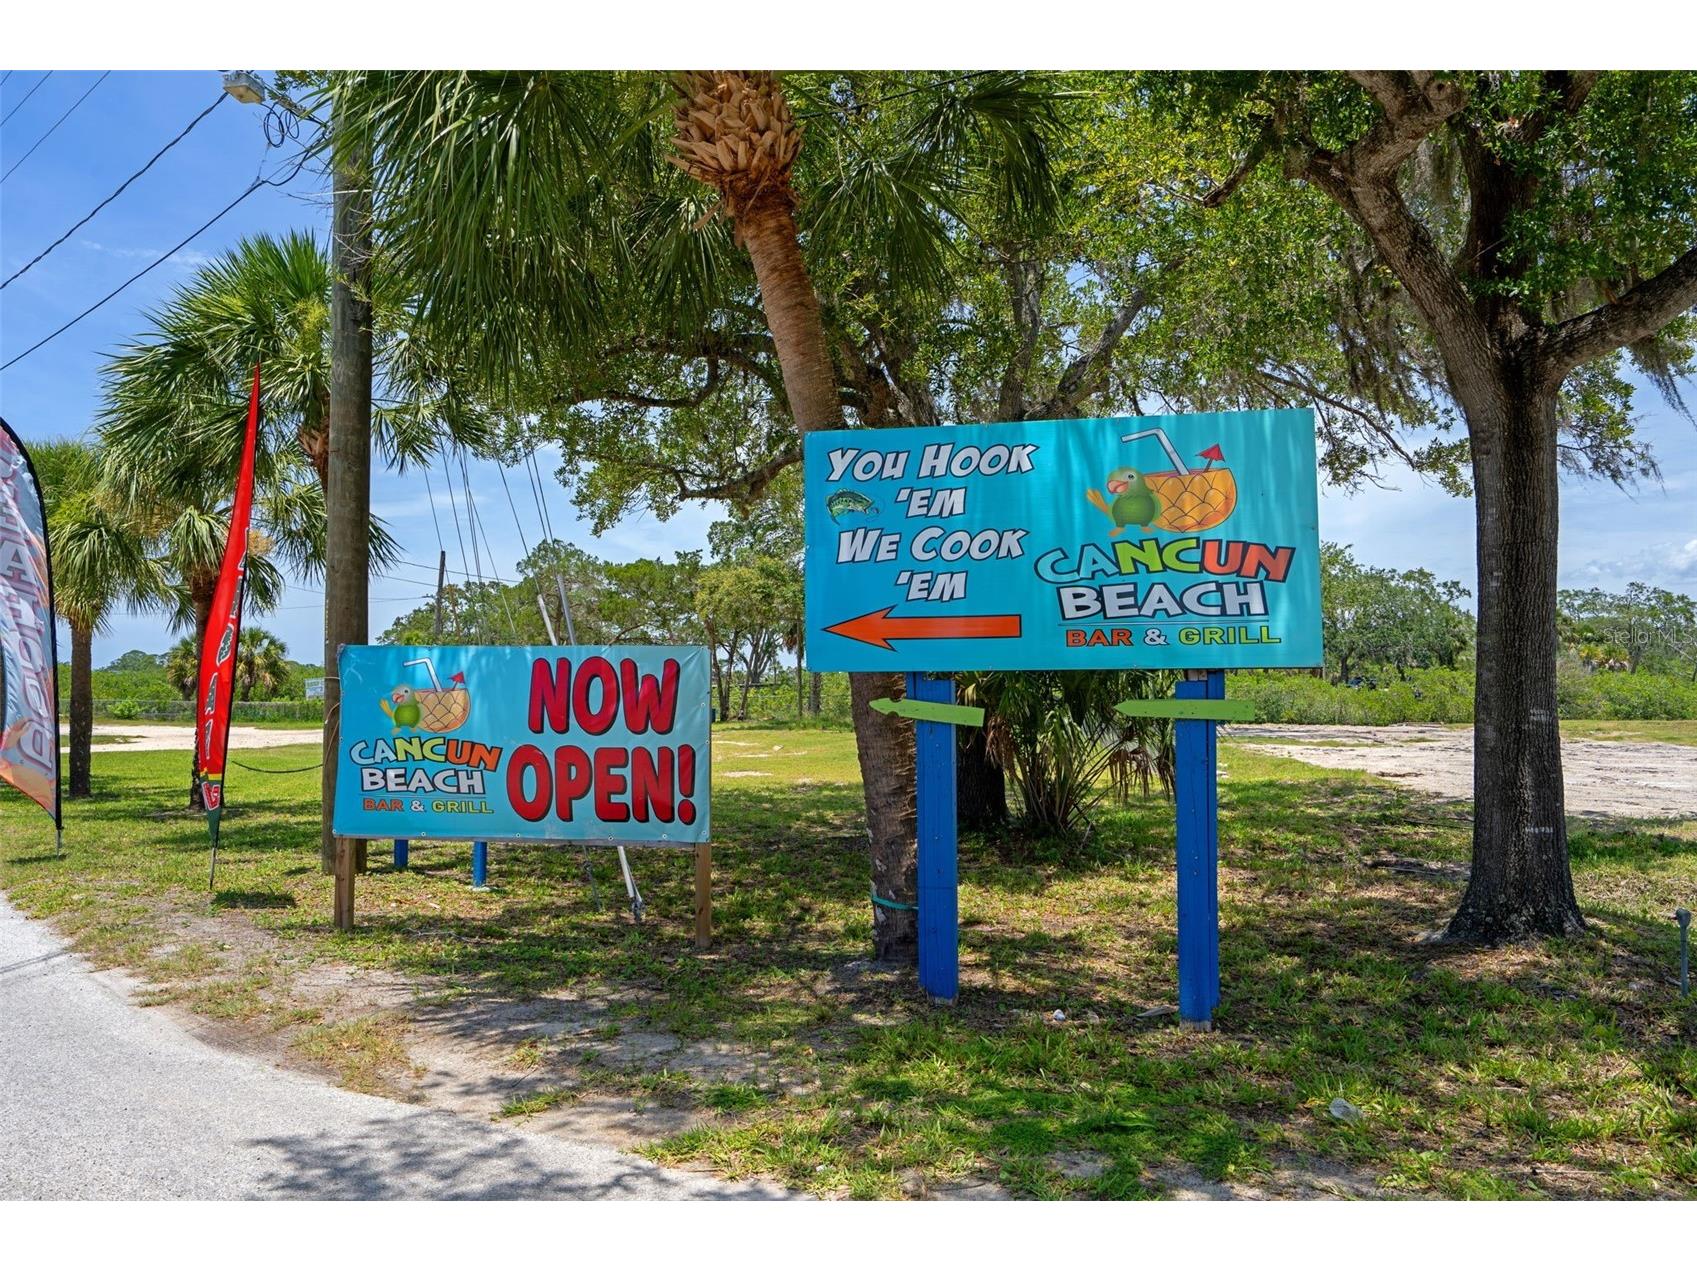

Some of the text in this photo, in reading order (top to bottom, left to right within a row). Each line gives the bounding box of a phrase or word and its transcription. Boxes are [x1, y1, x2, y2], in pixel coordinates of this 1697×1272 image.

[826, 442, 1040, 482] YOU HOOK
[895, 487, 967, 518] 'EM
[836, 526, 1030, 564] WE COOK
[1034, 537, 1296, 583] CANCUN
[895, 570, 968, 603] 'EM
[1056, 581, 1269, 620] BEACH
[1066, 625, 1281, 647] BAR & GRILL
[527, 656, 681, 736] NOW
[350, 737, 503, 772] CANCUN
[361, 767, 487, 795] BEACH
[506, 743, 697, 825] OPEN!
[362, 797, 495, 815] BAR & GRILL
